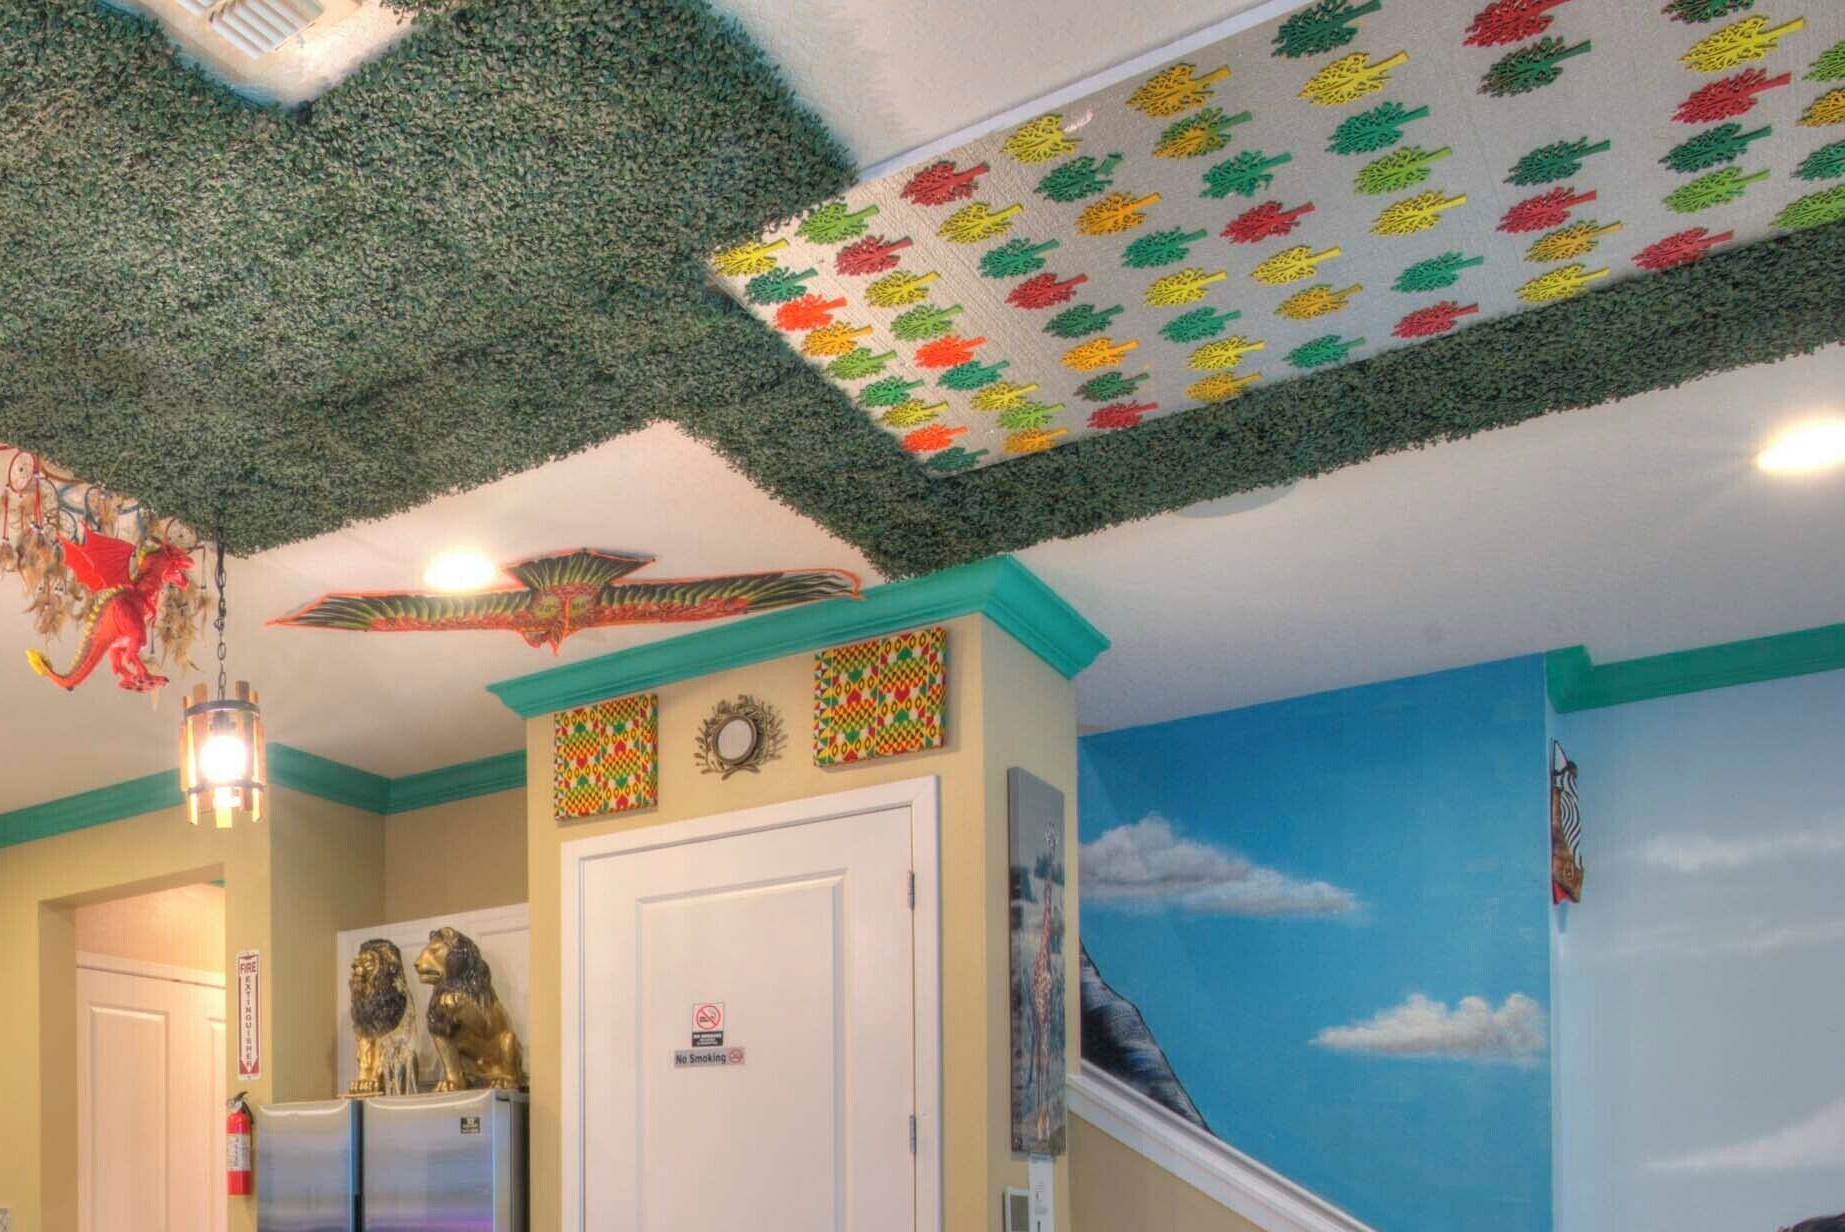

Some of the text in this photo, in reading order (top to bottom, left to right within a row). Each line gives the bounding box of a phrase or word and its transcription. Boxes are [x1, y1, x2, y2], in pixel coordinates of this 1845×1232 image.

[240, 961, 257, 973] FIRE
[676, 1053, 726, 1064] No Smoking
